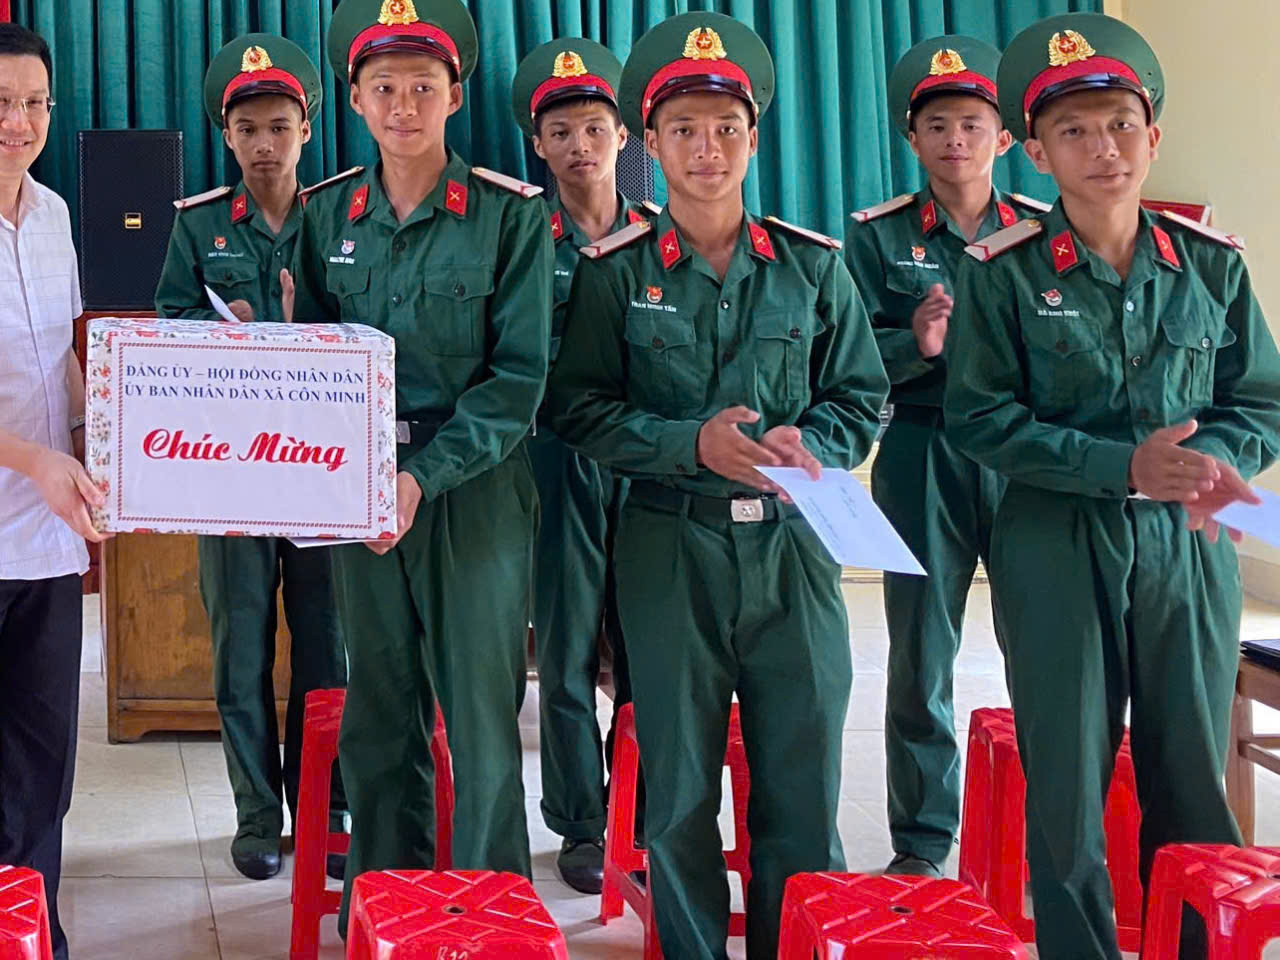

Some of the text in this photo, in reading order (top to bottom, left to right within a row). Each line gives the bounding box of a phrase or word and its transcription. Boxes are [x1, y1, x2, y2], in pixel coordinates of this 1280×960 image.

[208, 365, 234, 382] HỘI
[286, 367, 329, 383] NHÂN
[333, 368, 364, 384] DÂN
[149, 384, 178, 398] BAN
[183, 383, 224, 399] NHÂN
[229, 384, 260, 400] DÂN
[263, 386, 284, 401] XÃ
[288, 386, 320, 401] CÔN
[325, 390, 365, 404] MINH
[142, 428, 349, 472] Chúc Mừng
